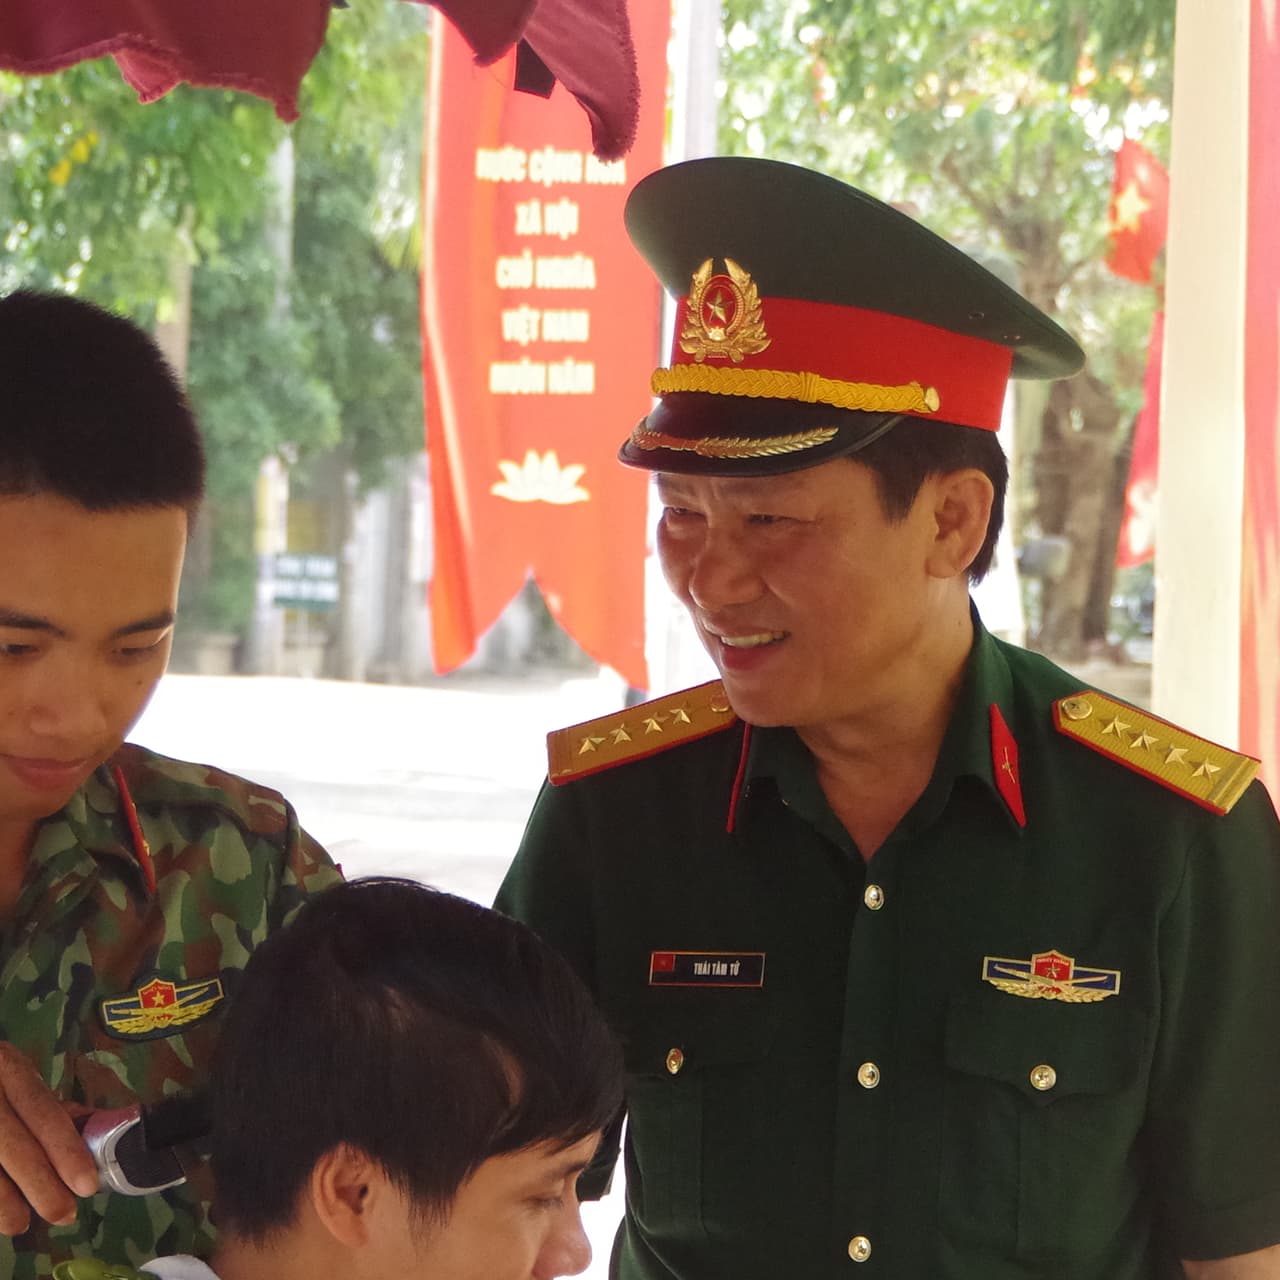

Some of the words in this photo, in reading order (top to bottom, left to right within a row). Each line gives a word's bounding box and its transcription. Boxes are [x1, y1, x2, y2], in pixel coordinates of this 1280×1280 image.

[530, 147, 582, 185] CỘNG
[545, 199, 578, 237] HỘI
[497, 251, 532, 287] CHỦ
[537, 255, 595, 287] NGHĨA
[503, 307, 539, 343] VIỆT
[543, 312, 588, 341] NAM
[549, 359, 594, 392] NĂM
